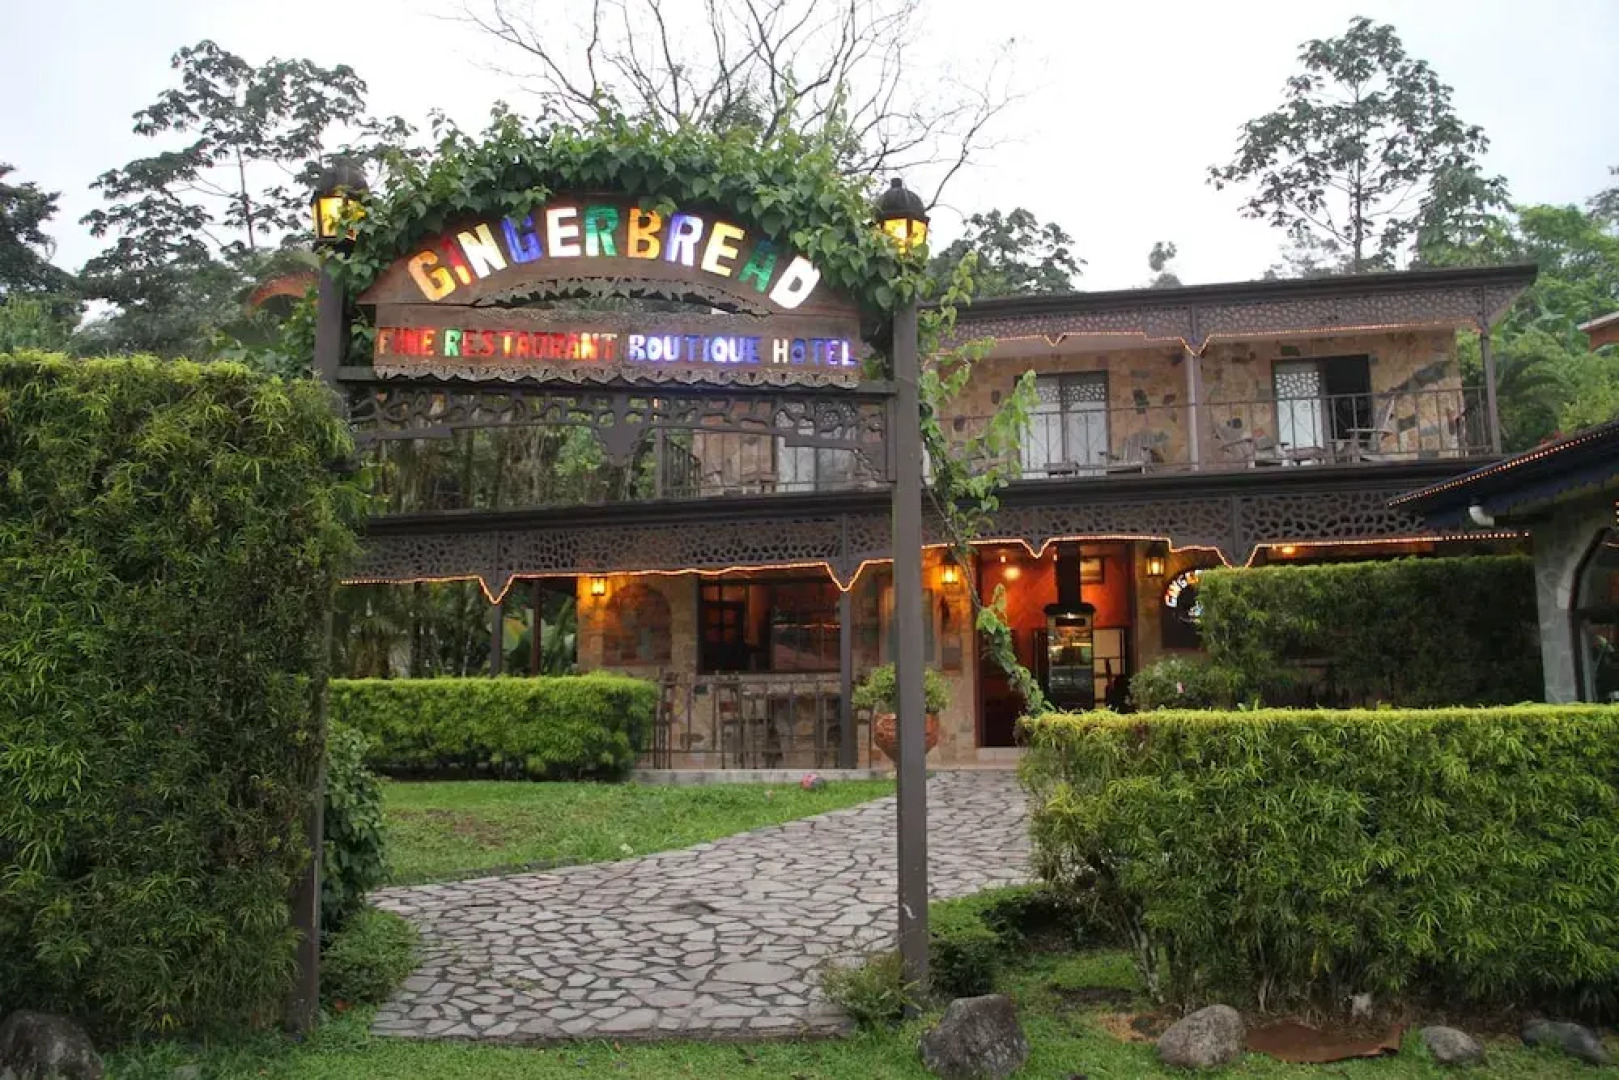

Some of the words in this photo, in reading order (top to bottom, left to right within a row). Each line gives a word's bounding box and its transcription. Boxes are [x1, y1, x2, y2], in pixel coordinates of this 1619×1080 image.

[407, 203, 821, 310] GINGERBREAD
[376, 326, 436, 357] FINE
[442, 328, 618, 360] RESTAURANT
[628, 334, 761, 364] BOUTIQUE
[773, 337, 859, 367] HOTEL
